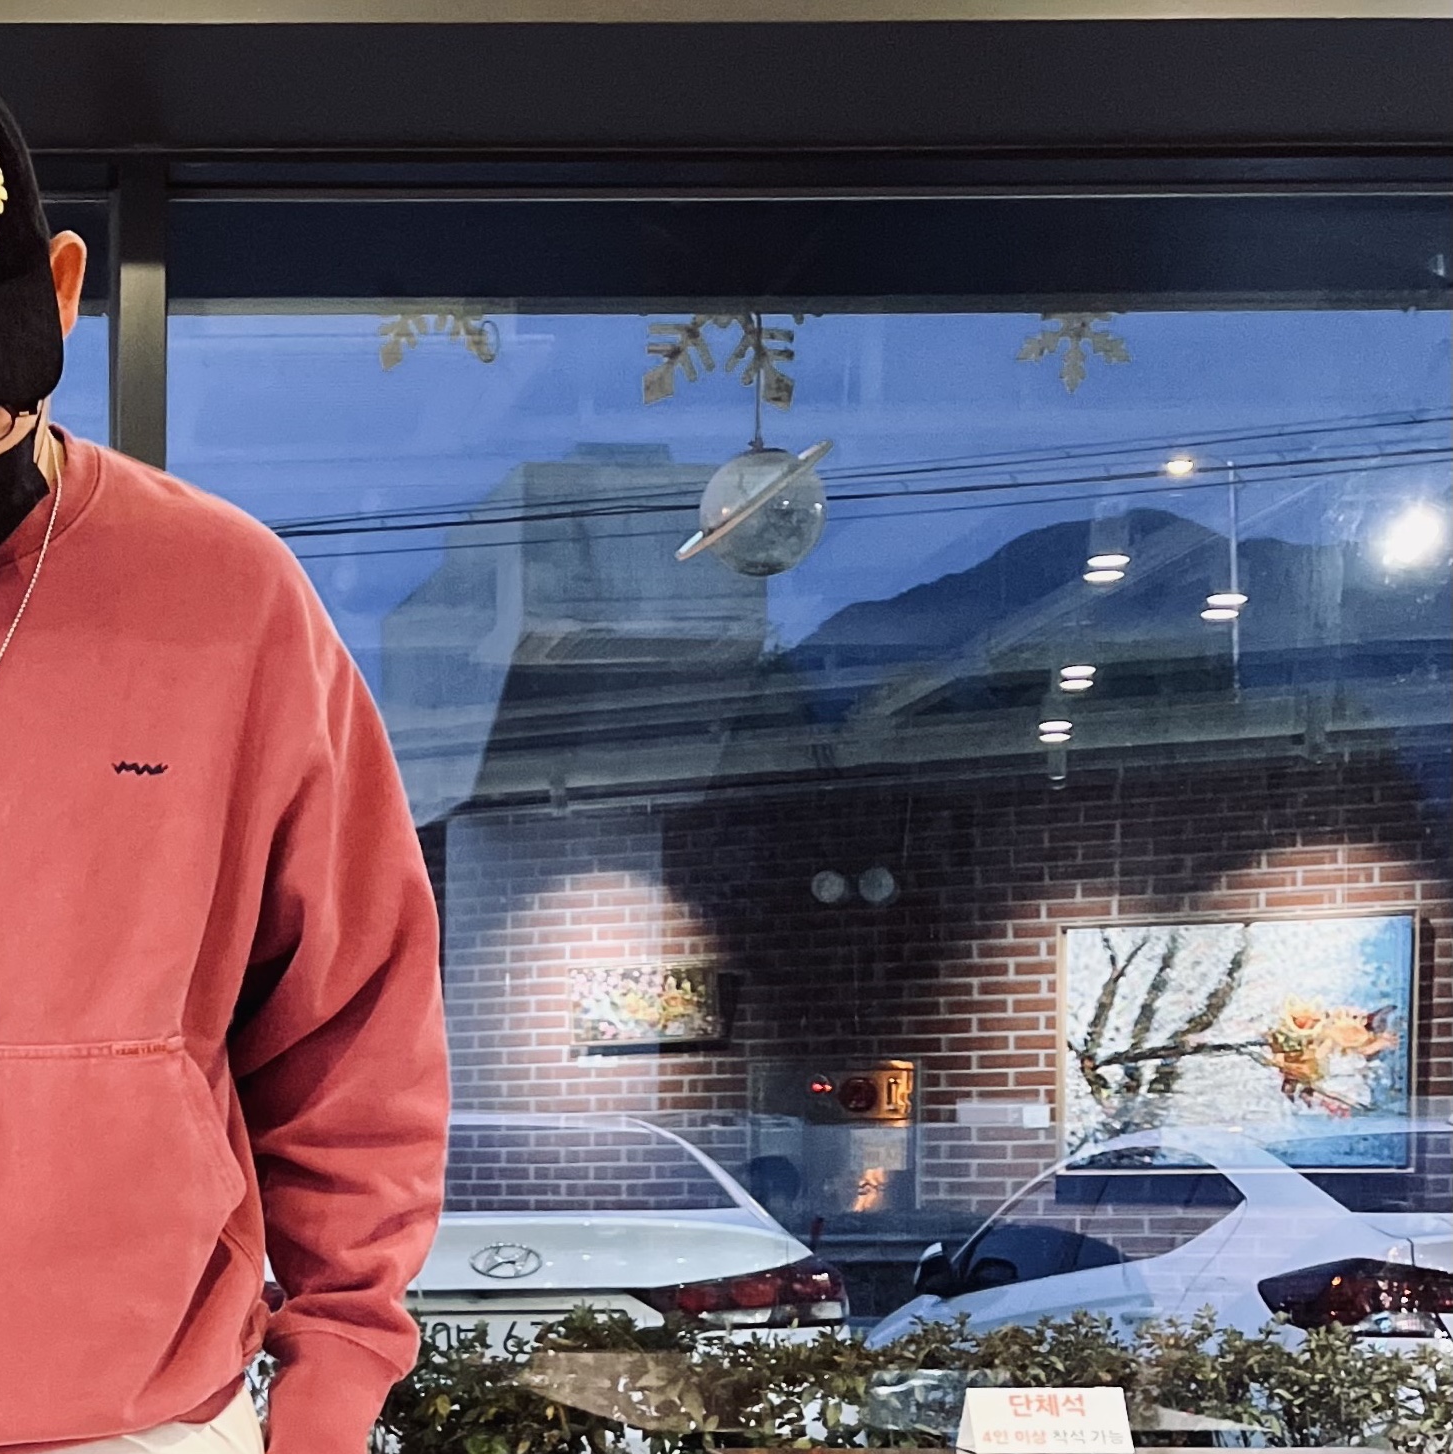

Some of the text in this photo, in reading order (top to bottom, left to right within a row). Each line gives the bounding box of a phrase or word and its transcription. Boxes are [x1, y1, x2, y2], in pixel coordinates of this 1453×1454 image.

[1008, 1393, 1087, 1417] 단체석
[982, 1430, 1009, 1445] 4인
[1014, 1430, 1047, 1445] 이상
[1091, 1430, 1124, 1445] 가능
